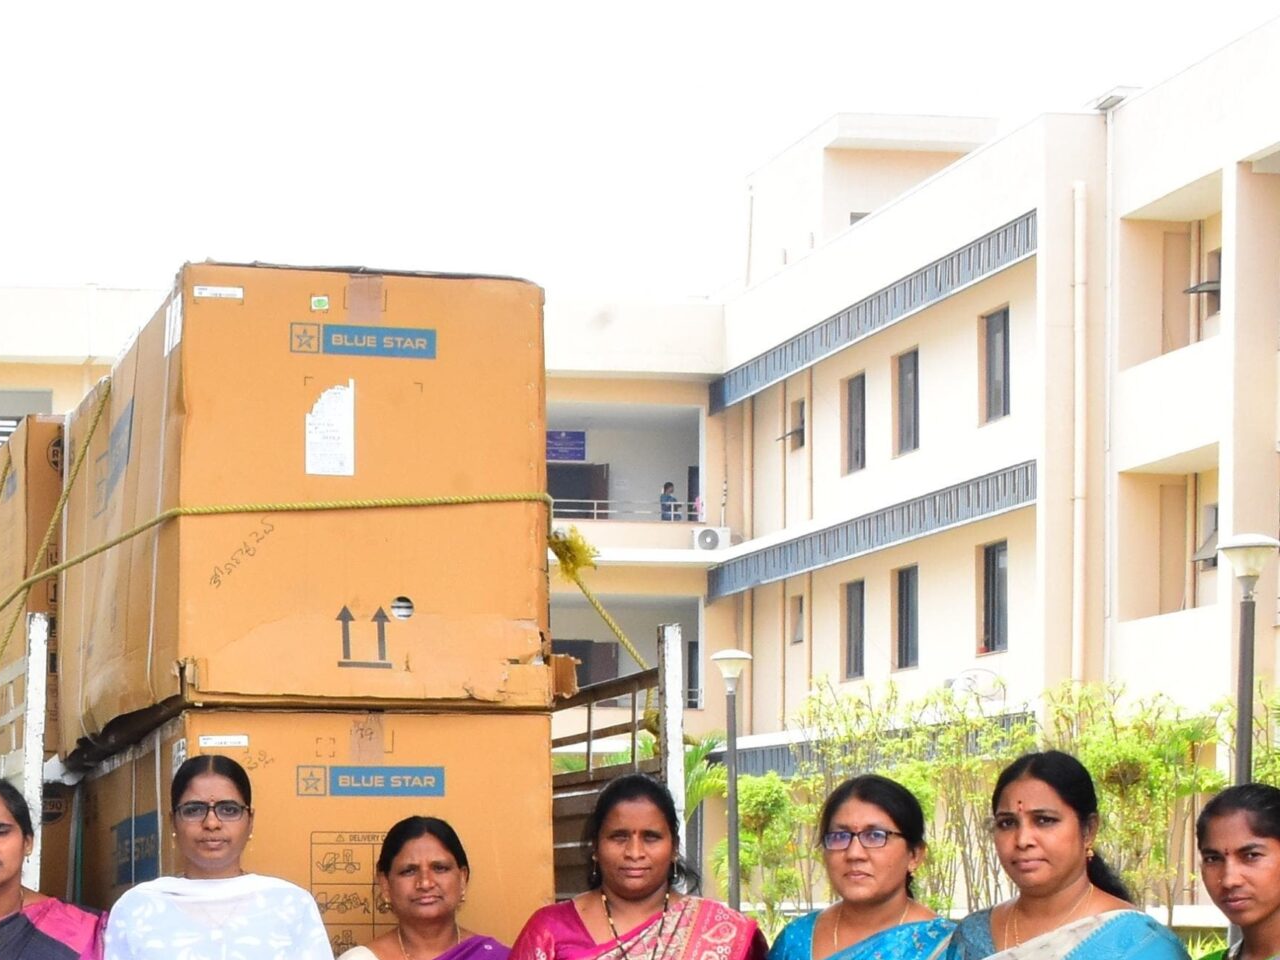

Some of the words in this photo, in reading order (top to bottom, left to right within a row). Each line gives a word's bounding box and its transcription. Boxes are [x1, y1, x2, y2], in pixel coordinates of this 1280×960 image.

[331, 333, 377, 348] BLUE
[383, 336, 428, 350] STAR
[338, 775, 385, 788] BLUE
[390, 775, 436, 788] STAR
[349, 834, 380, 842] DELIVERY
